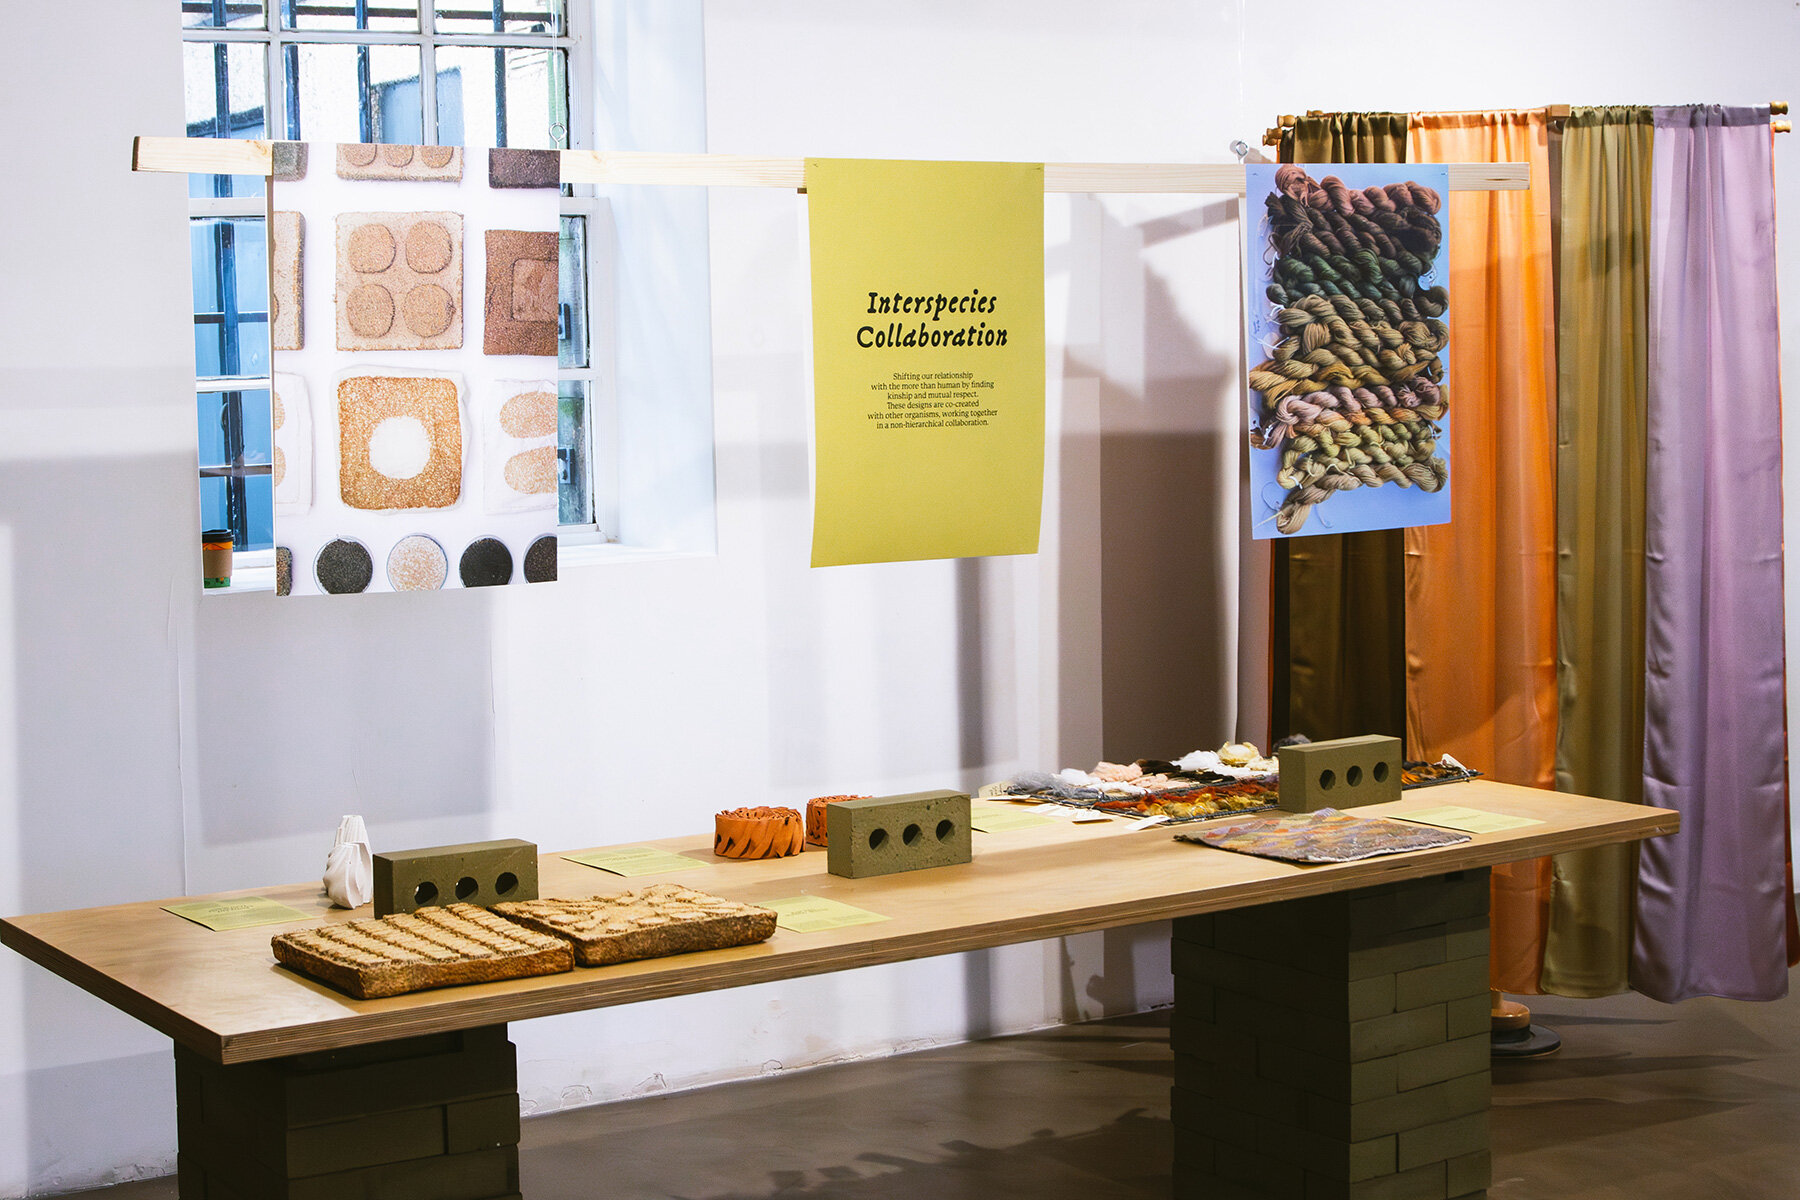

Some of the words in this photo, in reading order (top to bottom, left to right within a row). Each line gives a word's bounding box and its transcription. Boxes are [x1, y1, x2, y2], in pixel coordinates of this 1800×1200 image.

[867, 289, 997, 321] Interspecies
[857, 322, 1007, 348] Collaboration
[893, 373, 920, 381] Shifting
[934, 372, 973, 380] relationship
[961, 381, 970, 389] by
[971, 381, 994, 389] finding
[888, 392, 912, 400] kinship
[928, 391, 952, 399] mutual
[907, 401, 932, 410] designs
[945, 400, 979, 408] co-created
[905, 411, 940, 420] organisms,
[942, 410, 969, 418] working
[970, 409, 997, 418] together
[890, 420, 944, 428] non-hierarchical
[945, 419, 988, 427] collaboration.
